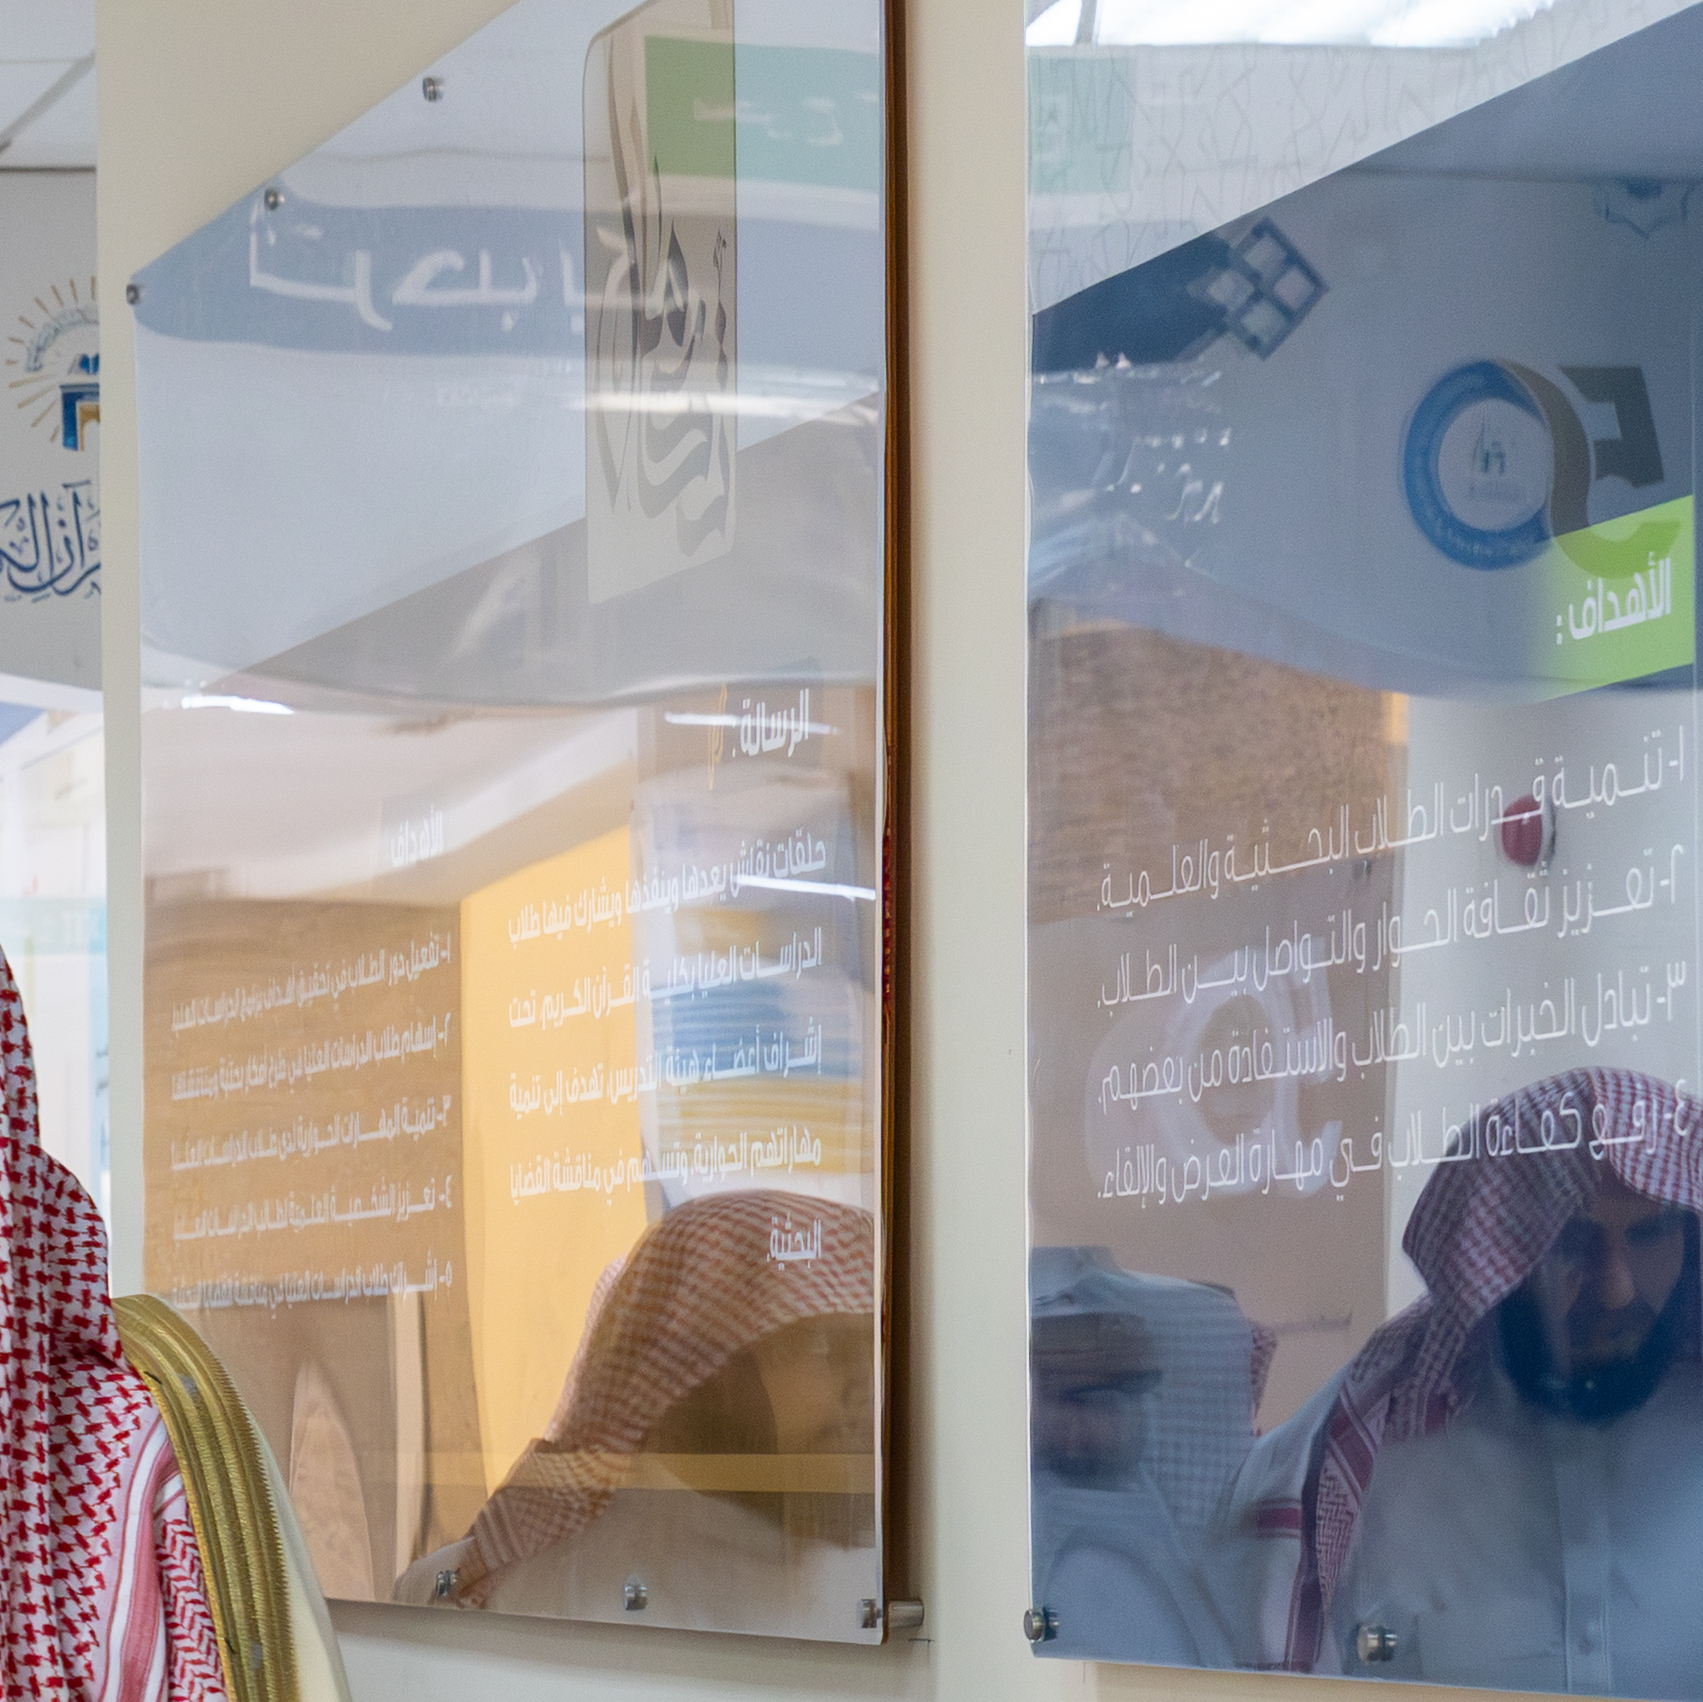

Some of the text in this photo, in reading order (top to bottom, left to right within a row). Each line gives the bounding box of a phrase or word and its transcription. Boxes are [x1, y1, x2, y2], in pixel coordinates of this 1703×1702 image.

[1224, 818, 1350, 892] البحثية
[1354, 781, 1444, 866] الطلاب
[1254, 908, 1366, 992] والتواصل
[1372, 887, 1458, 971] الحوار
[1182, 945, 1249, 1004] بين
[1582, 966, 1652, 1047] تبادل
[1352, 1002, 1427, 1080] الطلاب
[1433, 1010, 1476, 1068] بين
[1481, 976, 1576, 1058] الخبرات
[1188, 1049, 1223, 1103] من
[1172, 1132, 1245, 1202] العرض
[1329, 1116, 1384, 1202] في
[1388, 1103, 1481, 1181] الطلاب
